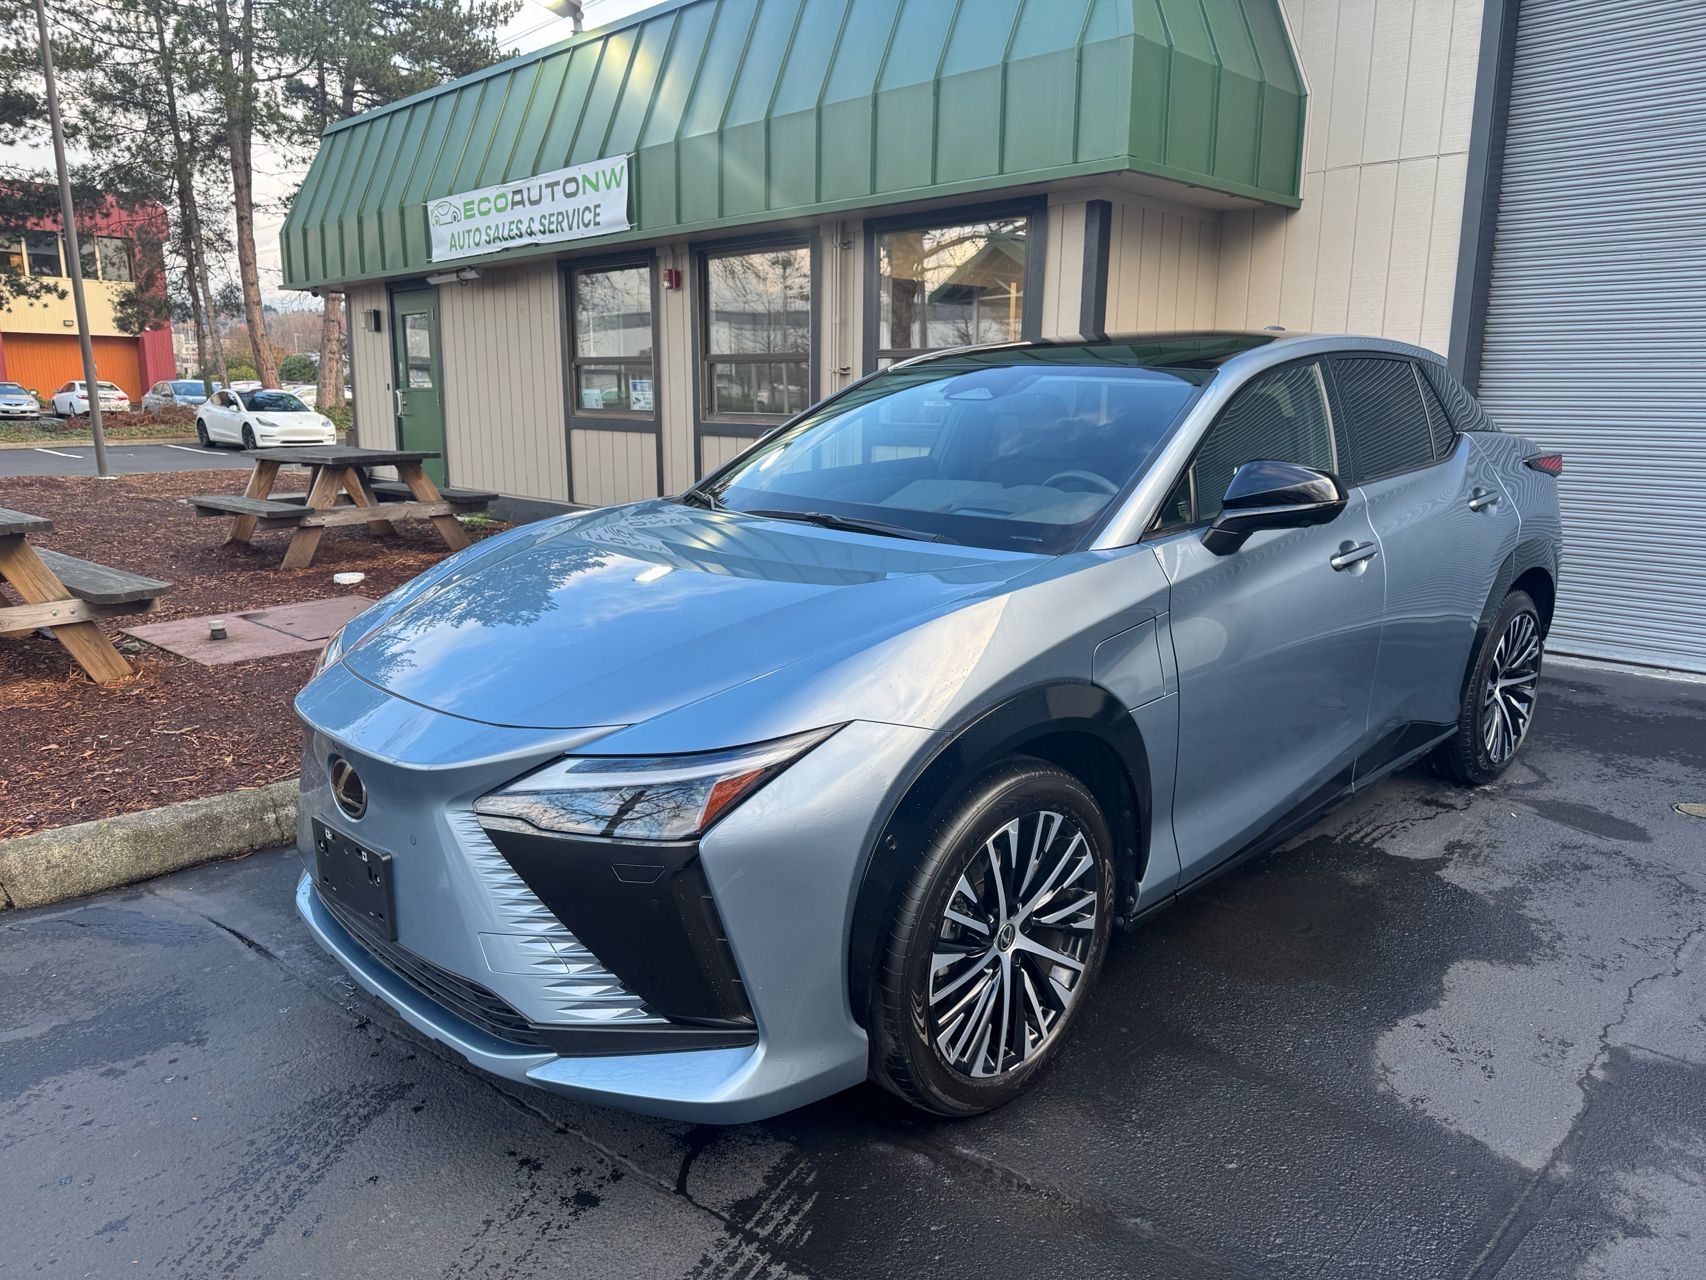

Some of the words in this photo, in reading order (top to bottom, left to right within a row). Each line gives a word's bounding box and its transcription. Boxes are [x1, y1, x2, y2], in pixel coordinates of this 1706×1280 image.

[463, 165, 625, 220] ECOAUTONW
[449, 229, 482, 252] AUTO
[484, 218, 524, 244] SALES
[525, 217, 537, 237] &
[538, 203, 602, 236] SERVICE
